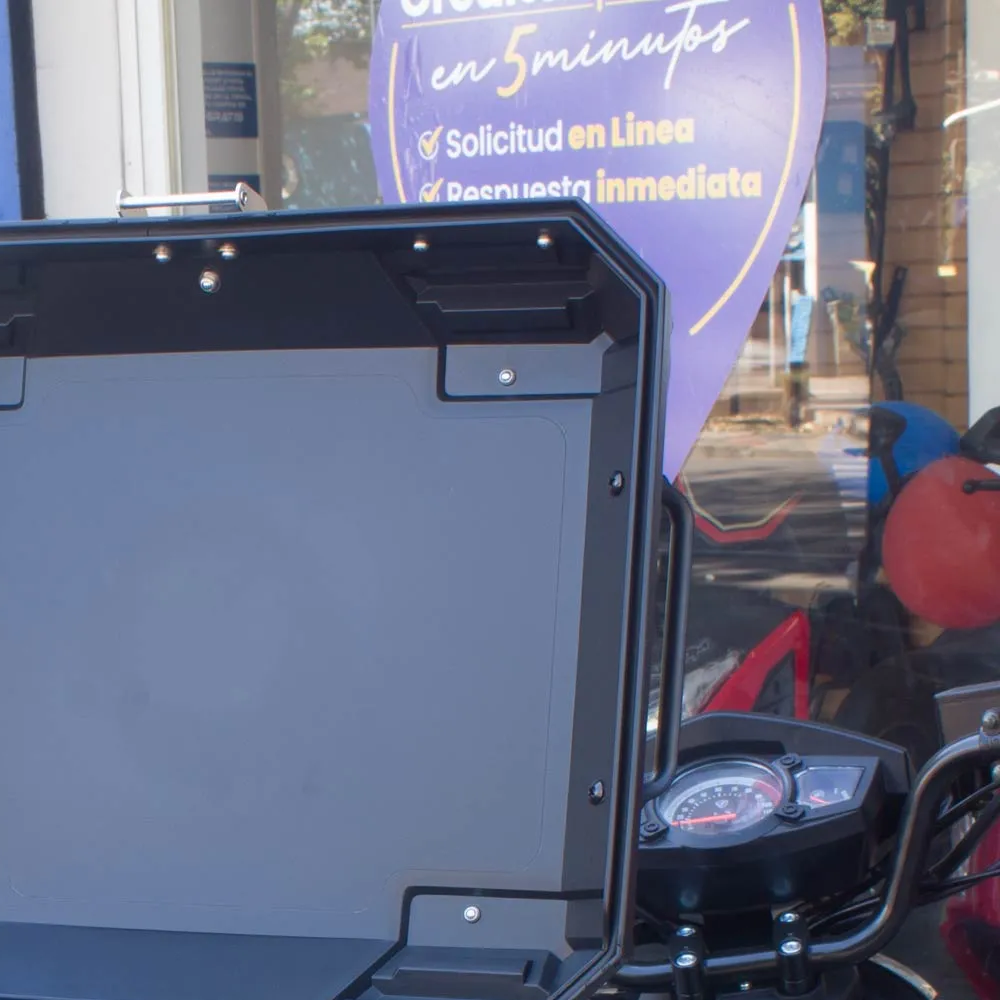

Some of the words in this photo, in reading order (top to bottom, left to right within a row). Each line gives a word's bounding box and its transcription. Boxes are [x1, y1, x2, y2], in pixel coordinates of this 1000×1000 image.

[430, 58, 497, 91] en
[496, 23, 538, 98] 5
[530, 0, 751, 90] minutos
[446, 119, 564, 159] Solicitud
[568, 123, 606, 150] en
[611, 111, 695, 148] Linea
[596, 164, 763, 203] inmediata
